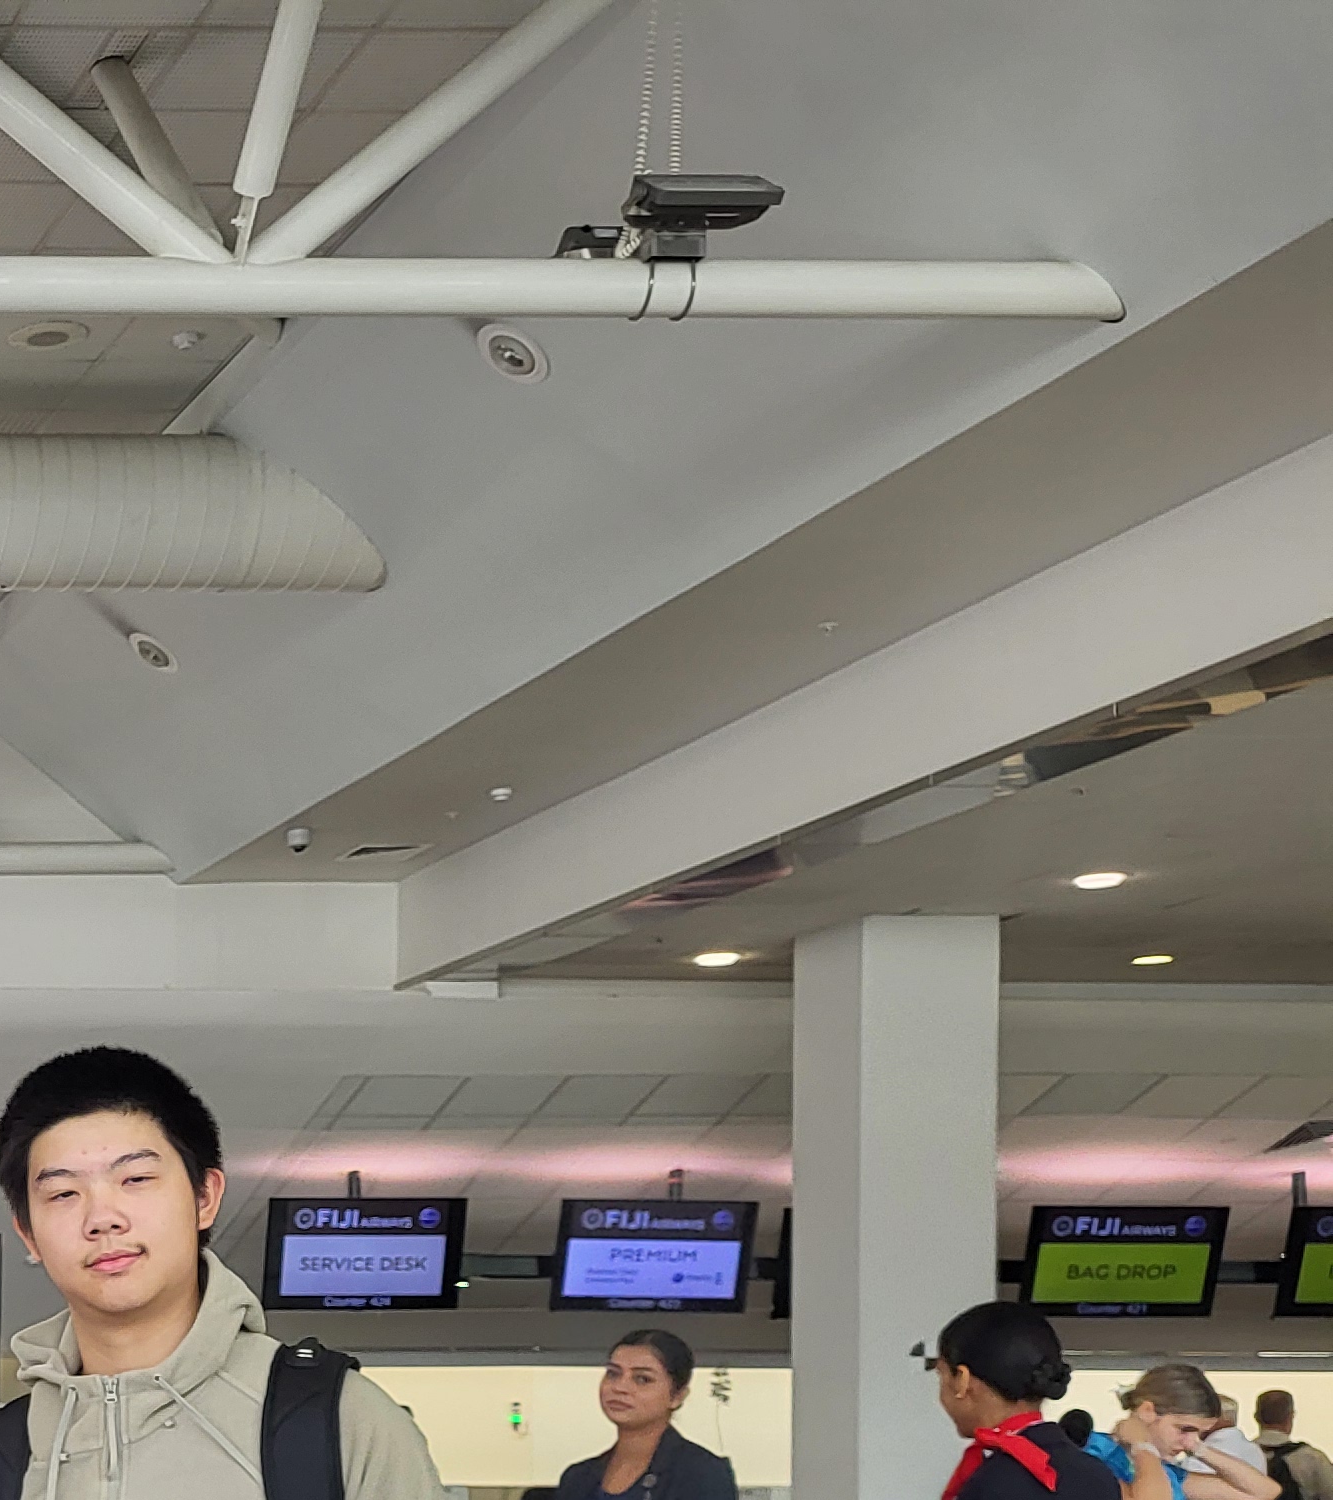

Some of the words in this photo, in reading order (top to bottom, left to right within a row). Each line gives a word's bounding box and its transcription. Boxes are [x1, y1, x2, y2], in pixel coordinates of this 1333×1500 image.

[315, 1208, 361, 1229] FIJI
[605, 1210, 651, 1230] FIJI
[1075, 1216, 1122, 1236] FIJI
[299, 1256, 374, 1272] SERVICE
[378, 1256, 428, 1272] DESK
[609, 1248, 698, 1263] PREMIUM
[1065, 1264, 1111, 1281] BAG
[1115, 1263, 1178, 1281] DROP
